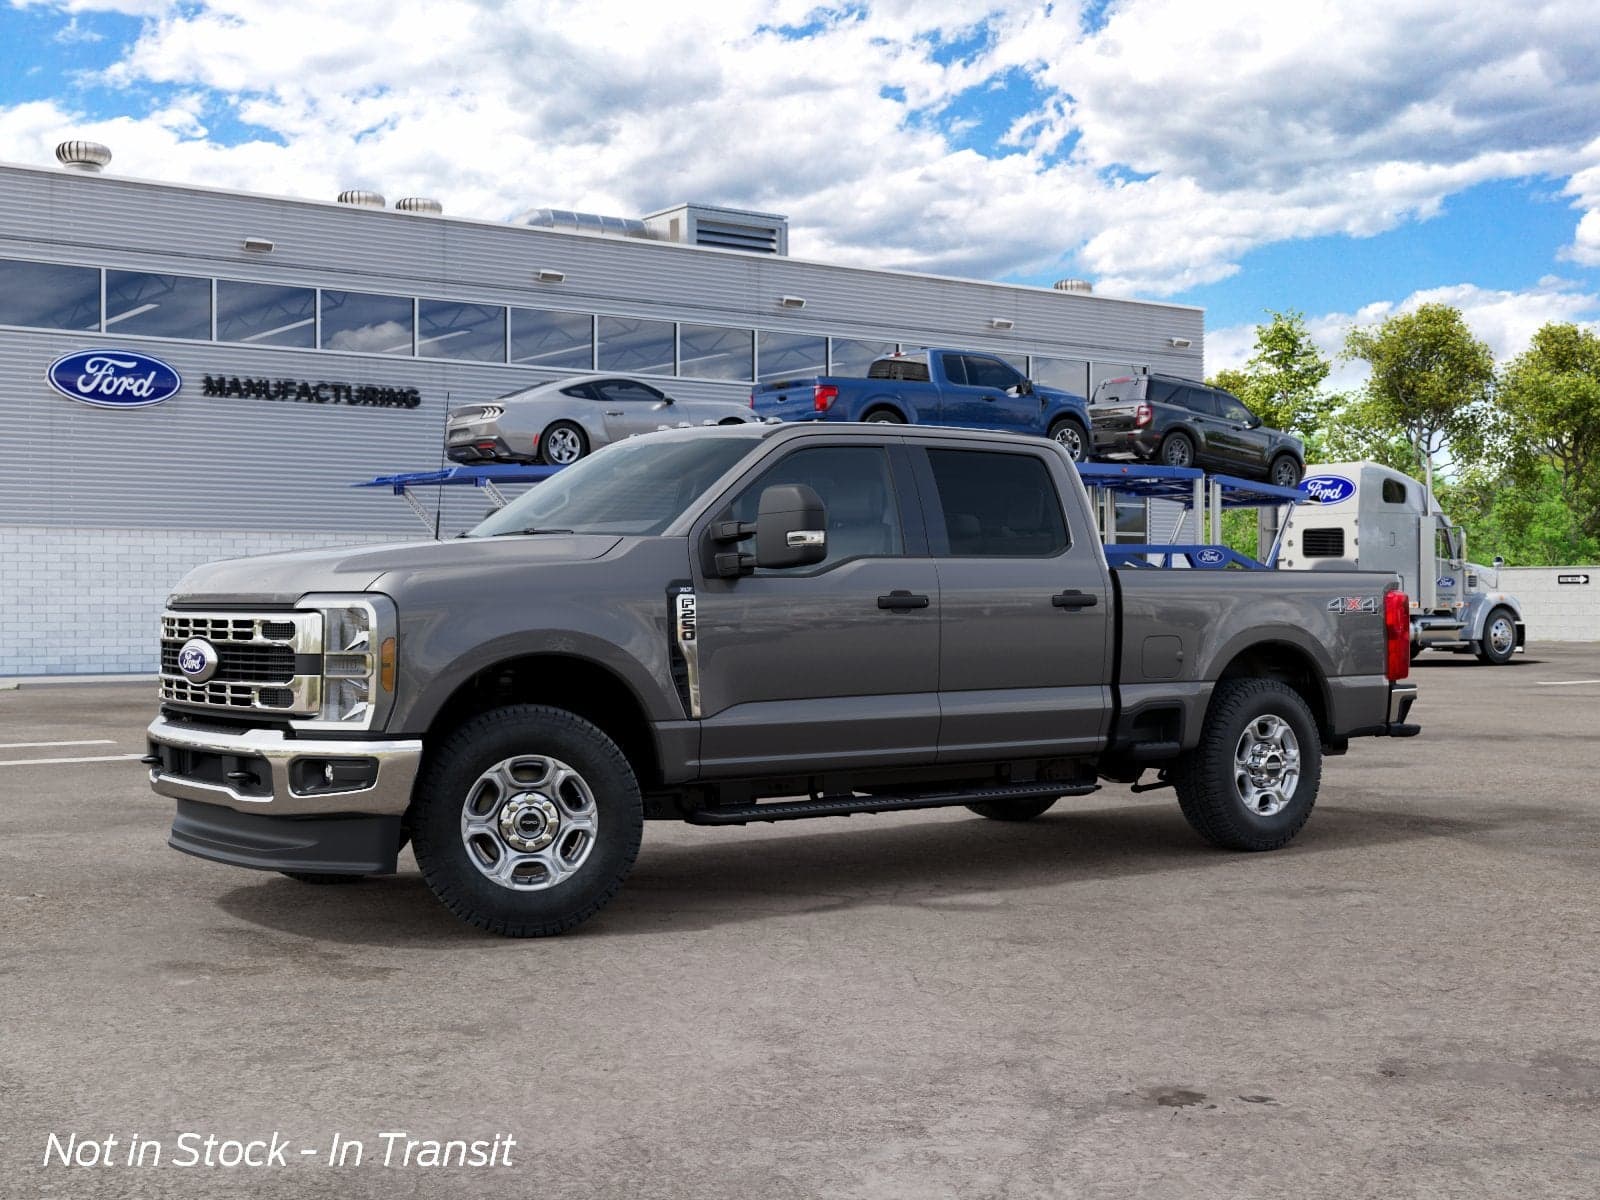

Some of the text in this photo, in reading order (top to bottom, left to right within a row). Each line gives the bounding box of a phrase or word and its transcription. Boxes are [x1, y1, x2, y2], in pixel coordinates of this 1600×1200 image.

[77, 356, 421, 409] Ford MANUFACTURING
[1307, 479, 1343, 500] Ford
[1201, 551, 1220, 561] Ford
[183, 650, 202, 670] Ford
